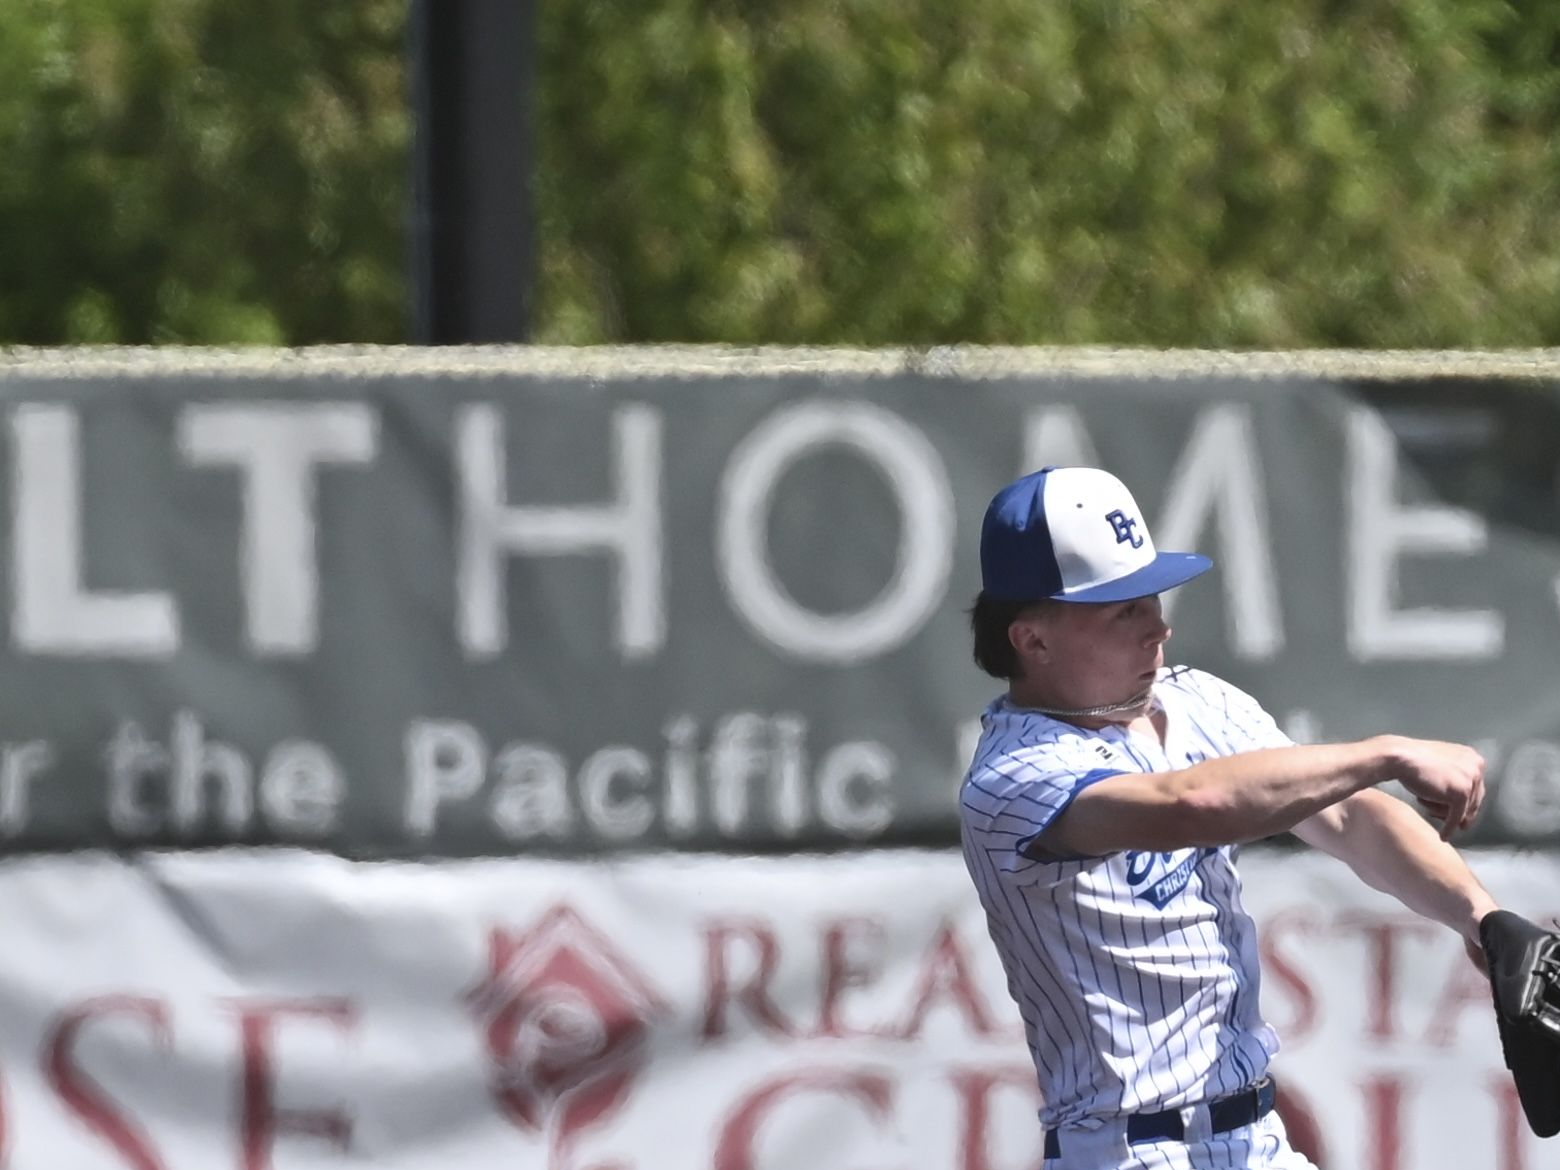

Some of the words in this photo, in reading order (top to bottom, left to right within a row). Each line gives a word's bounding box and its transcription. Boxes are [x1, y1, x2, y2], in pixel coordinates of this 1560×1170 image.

[1105, 509, 1143, 549] BC
[108, 708, 347, 843] the
[405, 712, 900, 845] Pacific
[698, 915, 1000, 1045] REA
